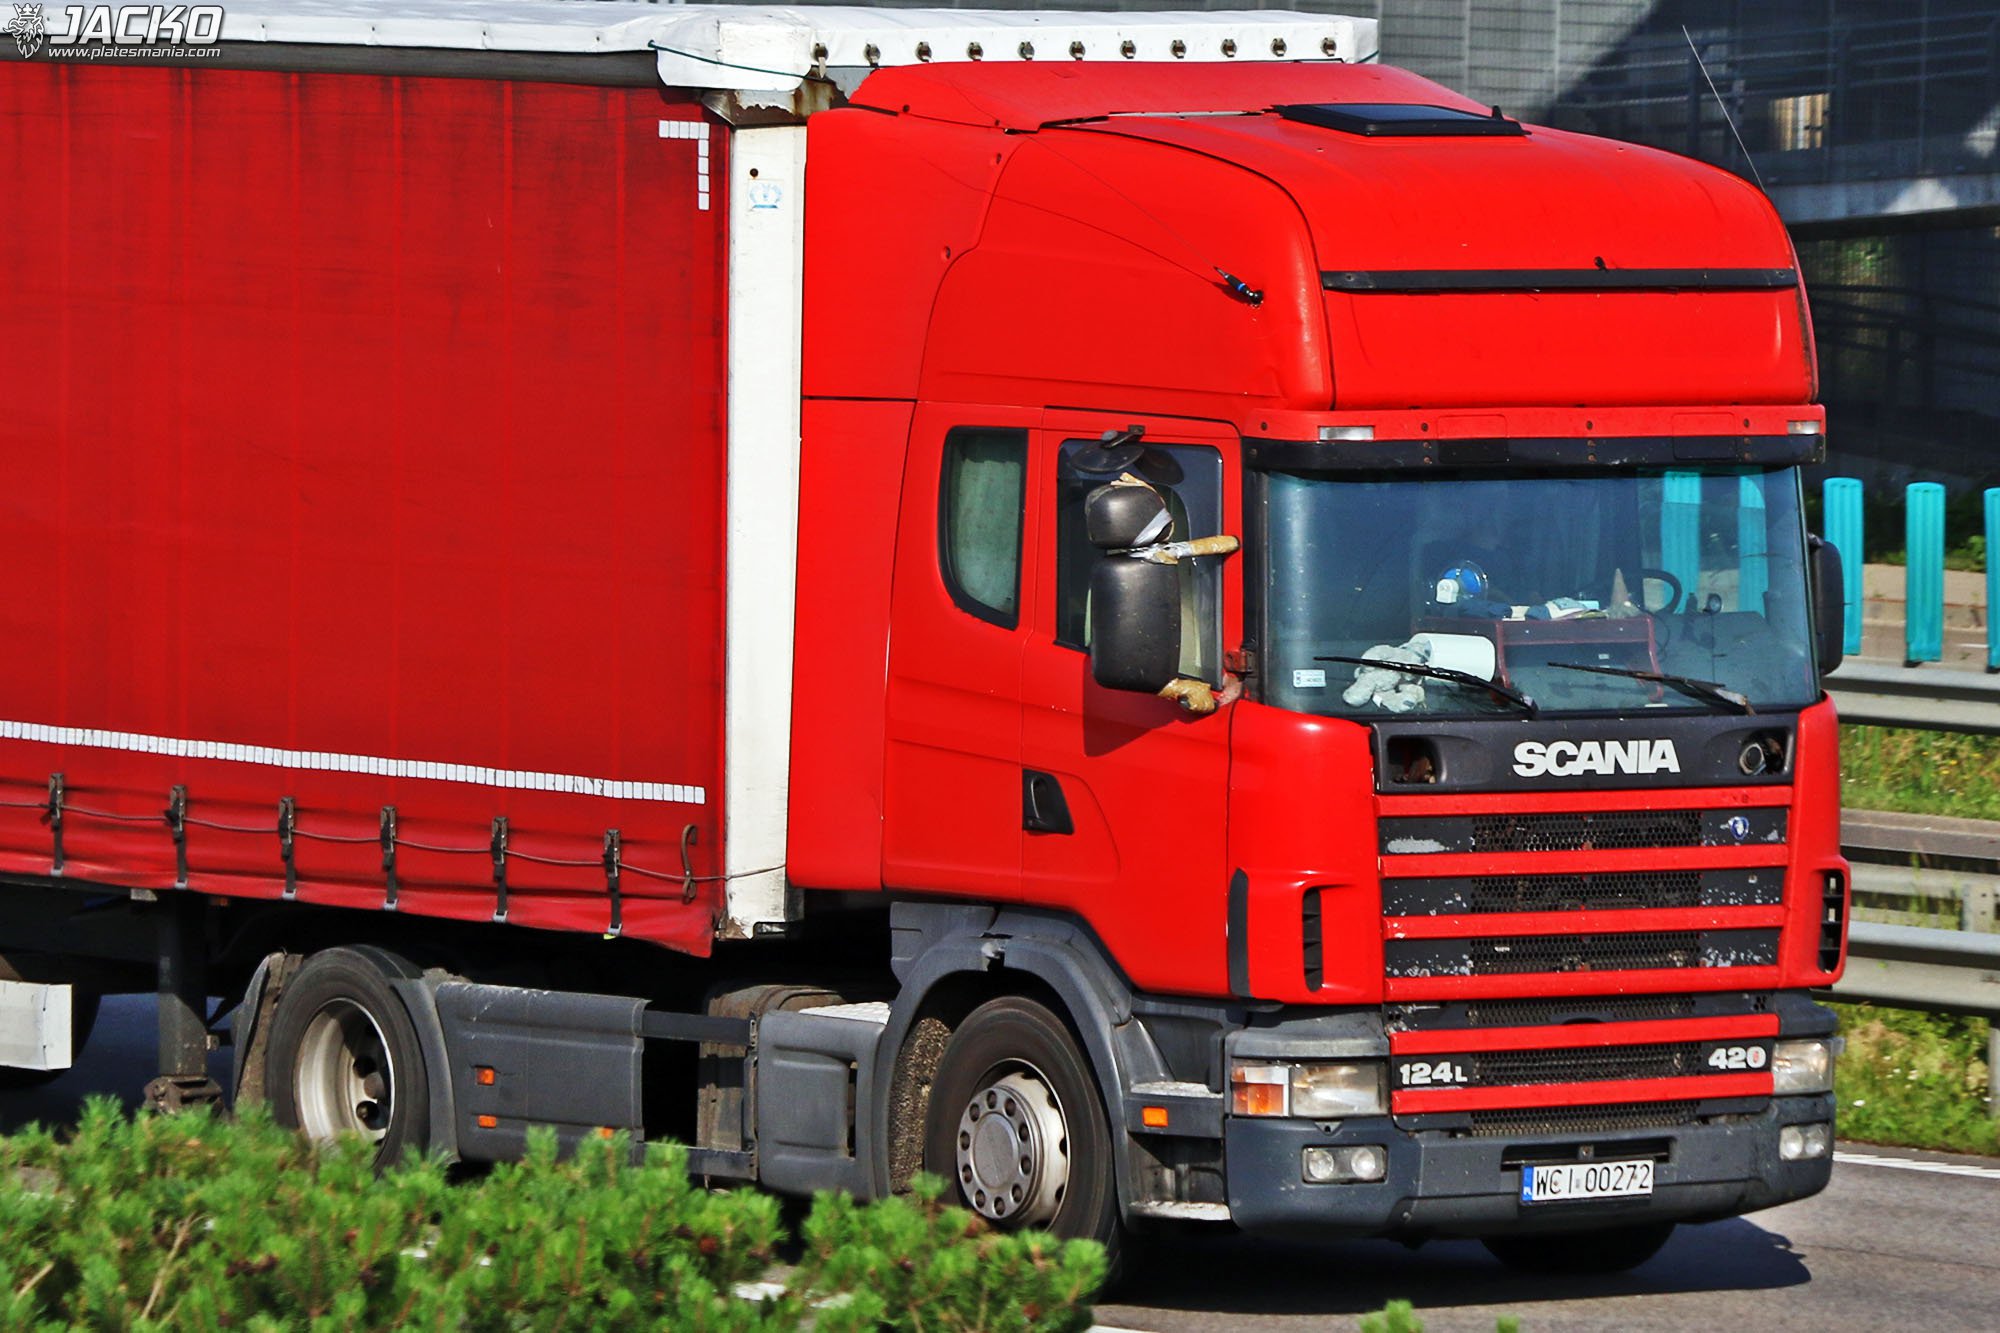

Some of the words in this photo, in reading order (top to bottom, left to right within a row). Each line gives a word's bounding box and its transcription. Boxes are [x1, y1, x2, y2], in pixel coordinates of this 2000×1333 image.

[1512, 739, 1681, 777] SCANIA
[1708, 1045, 1767, 1070] 420
[1536, 1168, 1573, 1196] WCI
[1585, 1164, 1650, 1193] 00272
